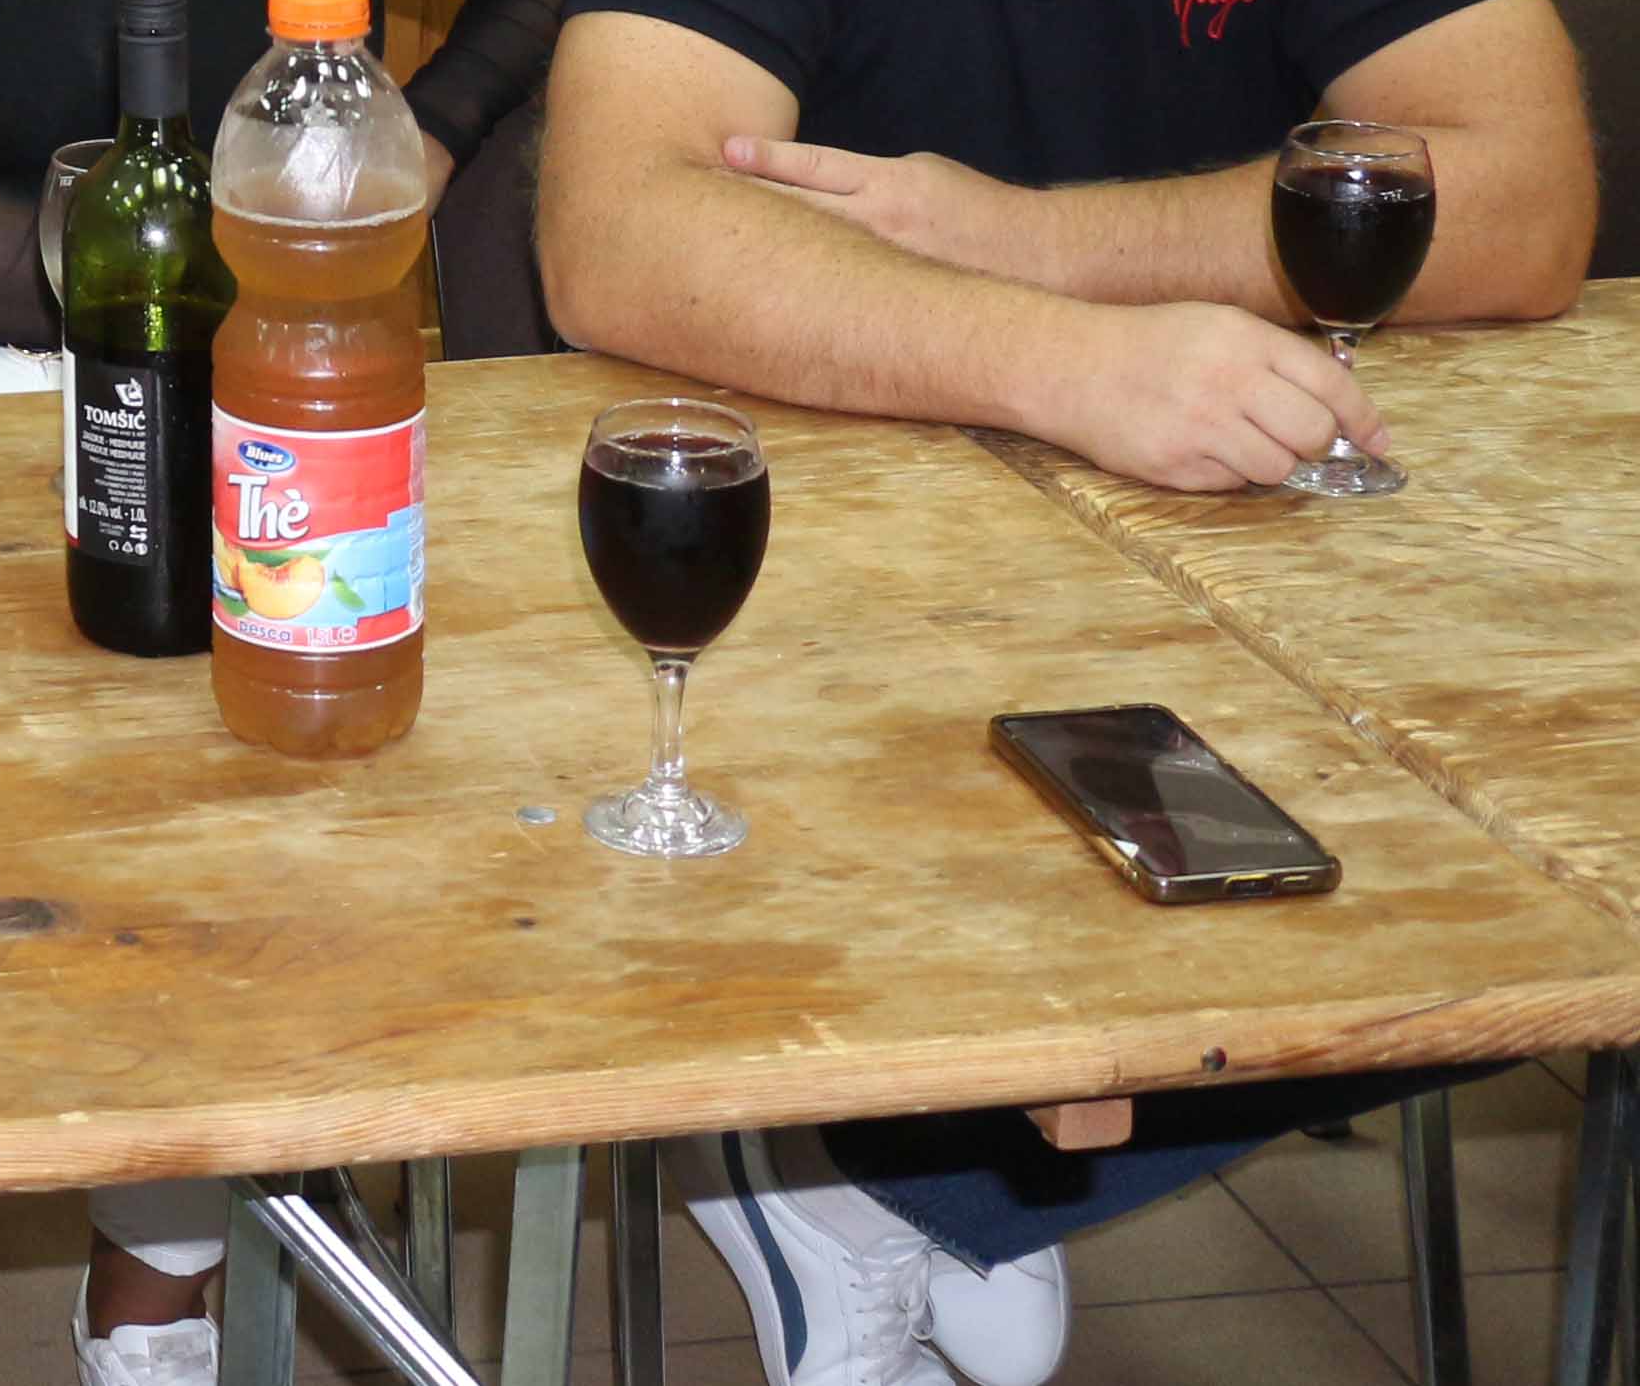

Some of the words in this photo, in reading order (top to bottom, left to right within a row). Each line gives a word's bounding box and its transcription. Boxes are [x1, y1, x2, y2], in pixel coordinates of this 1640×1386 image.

[83, 404, 147, 430] TOMŠIĆ
[245, 445, 284, 465] Blues
[228, 473, 311, 541] Thè
[238, 620, 291, 643] pesca
